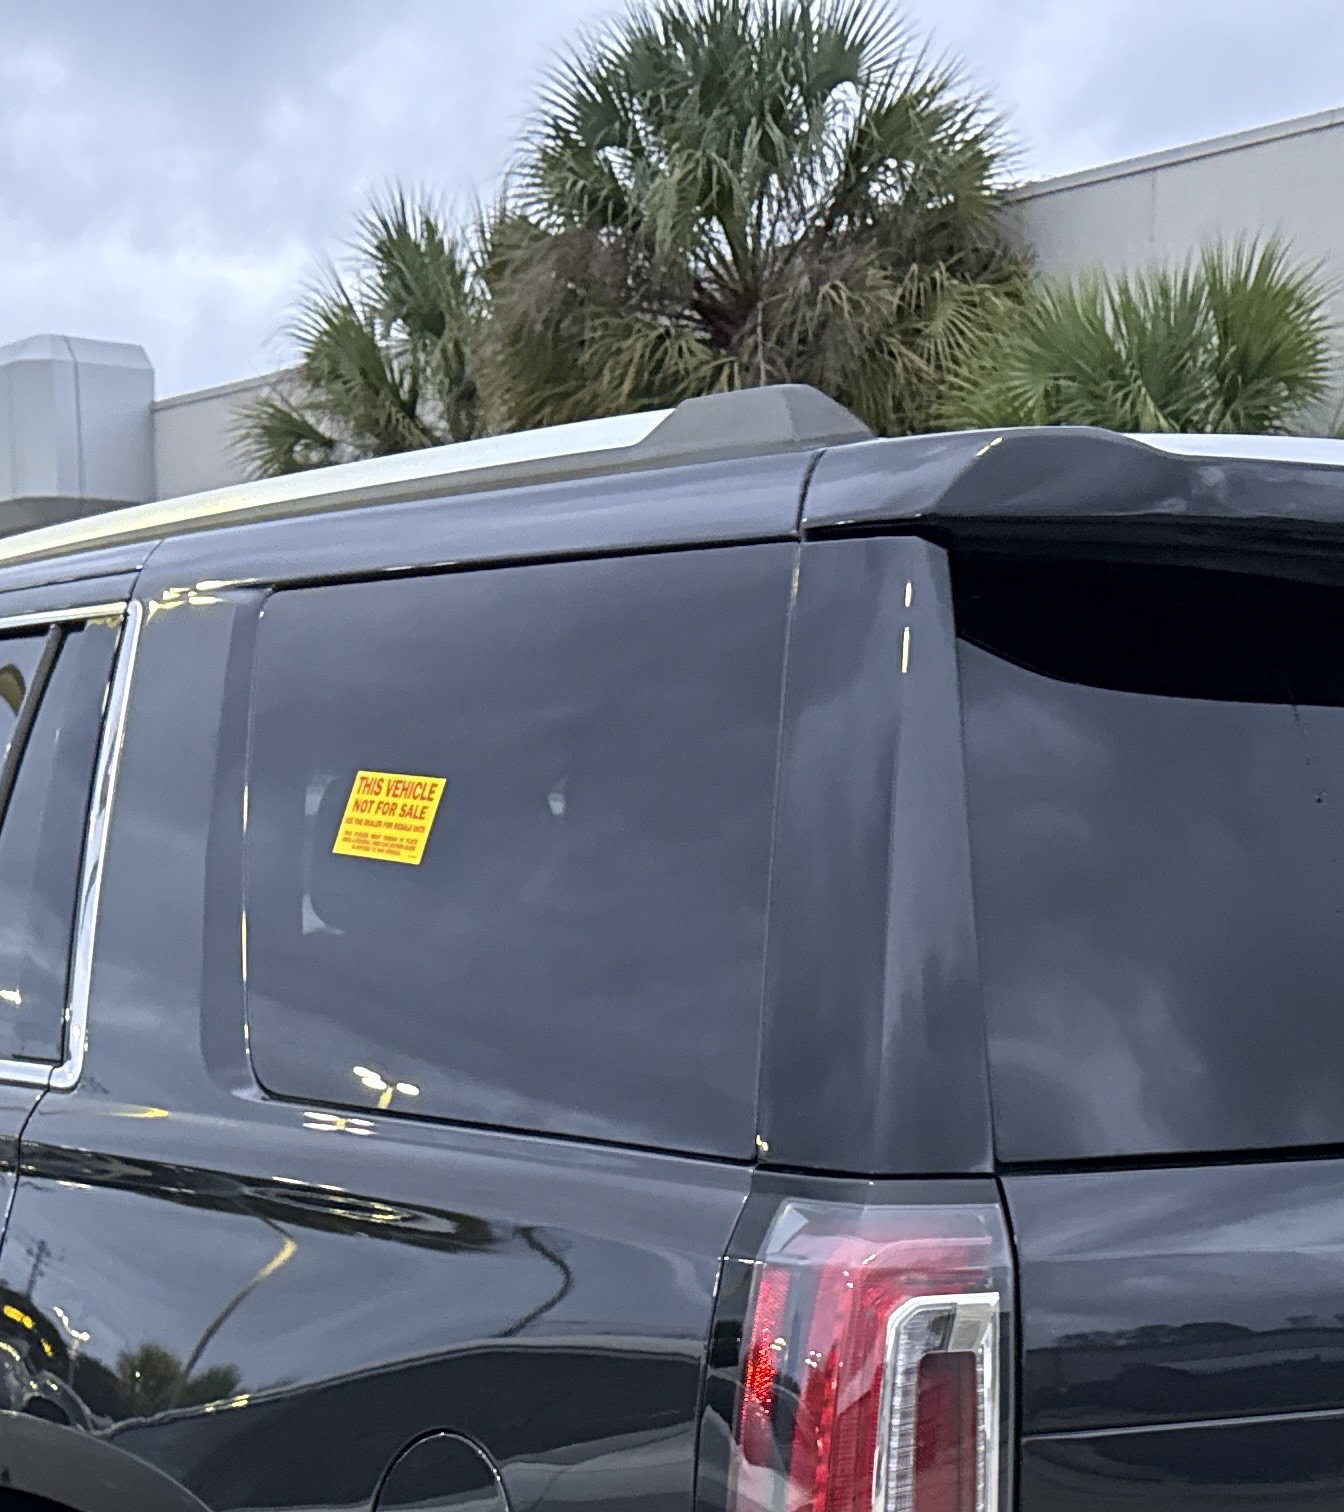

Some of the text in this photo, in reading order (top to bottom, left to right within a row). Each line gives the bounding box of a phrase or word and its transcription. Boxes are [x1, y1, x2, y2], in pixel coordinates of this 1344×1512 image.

[357, 776, 438, 802] THIS VEHICLE
[352, 799, 429, 820] NOT FOR SALE
